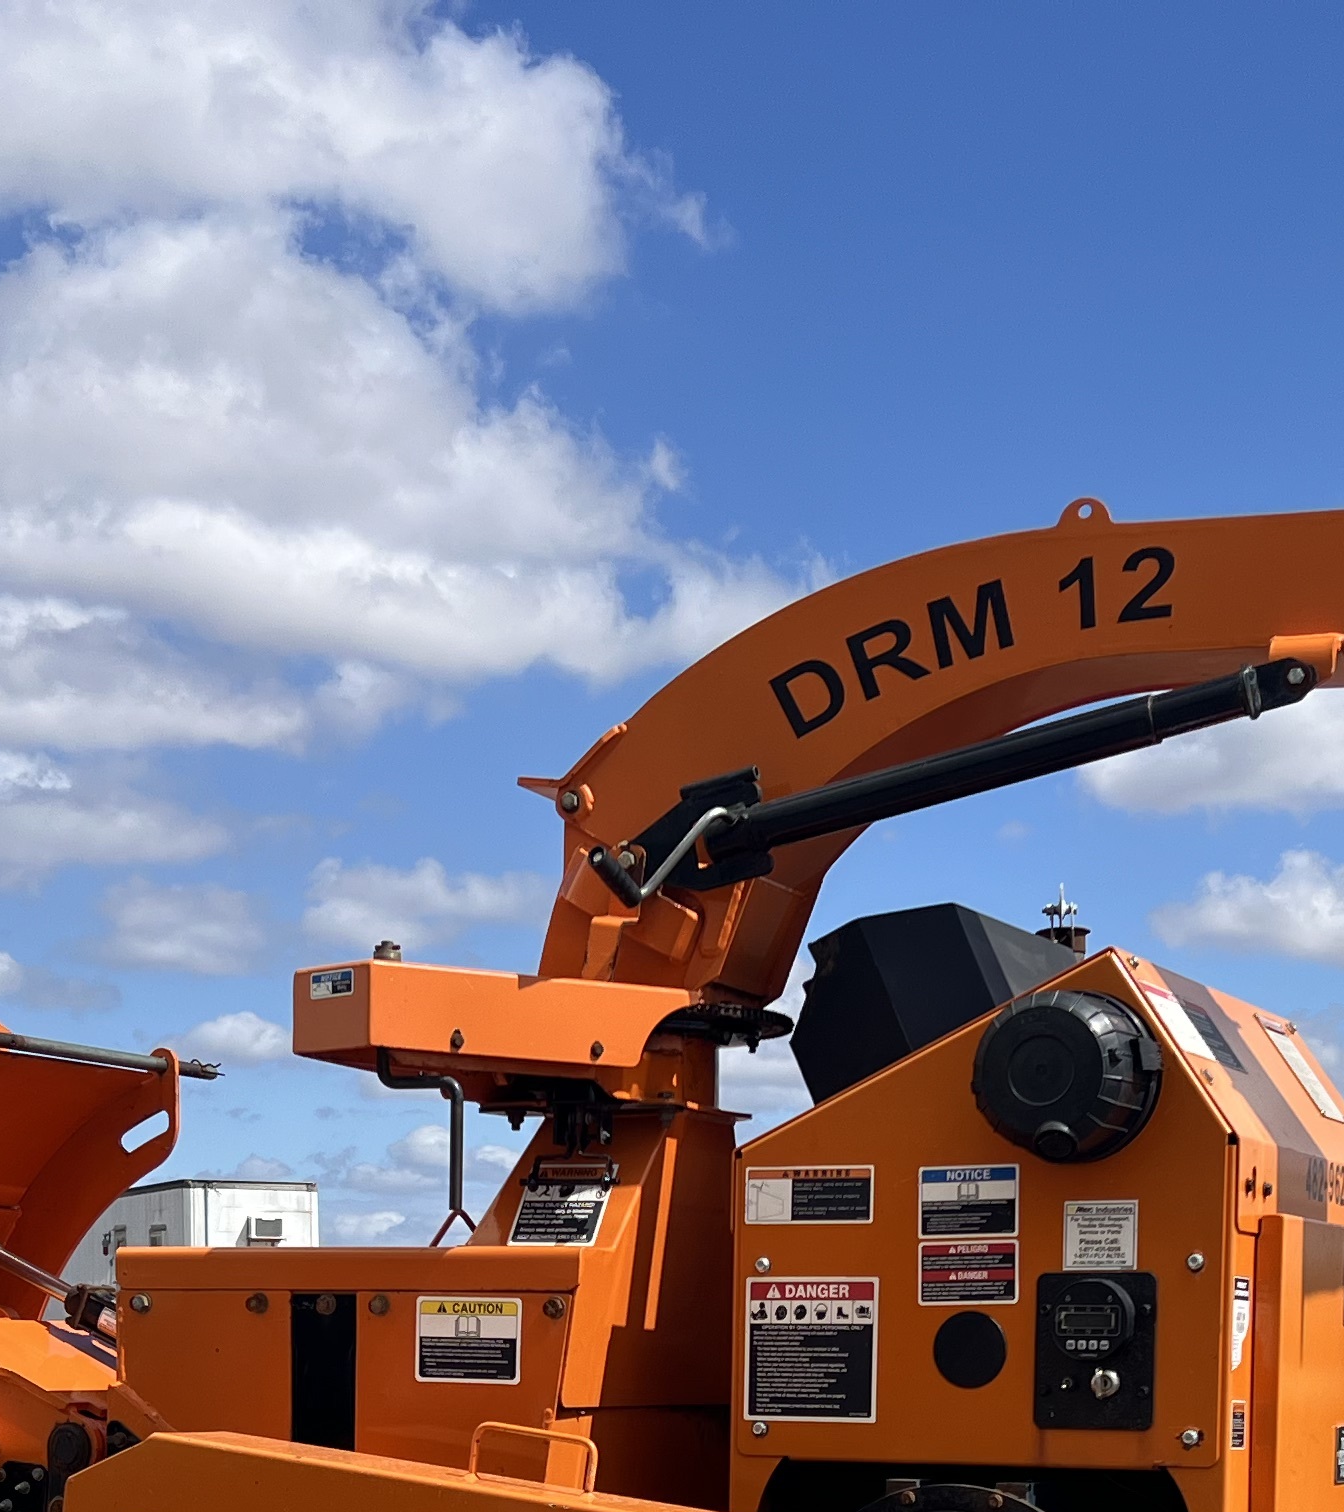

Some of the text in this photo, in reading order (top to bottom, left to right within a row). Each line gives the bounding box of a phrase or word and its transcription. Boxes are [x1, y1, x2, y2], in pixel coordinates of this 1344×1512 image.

[768, 546, 1176, 739] DRM 12
[946, 1169, 991, 1181] NOTICE
[957, 1245, 989, 1254] PELIGRO
[957, 1271, 988, 1280] DANGER
[785, 1284, 850, 1298] DANGER
[452, 1303, 503, 1314] CAUTION
